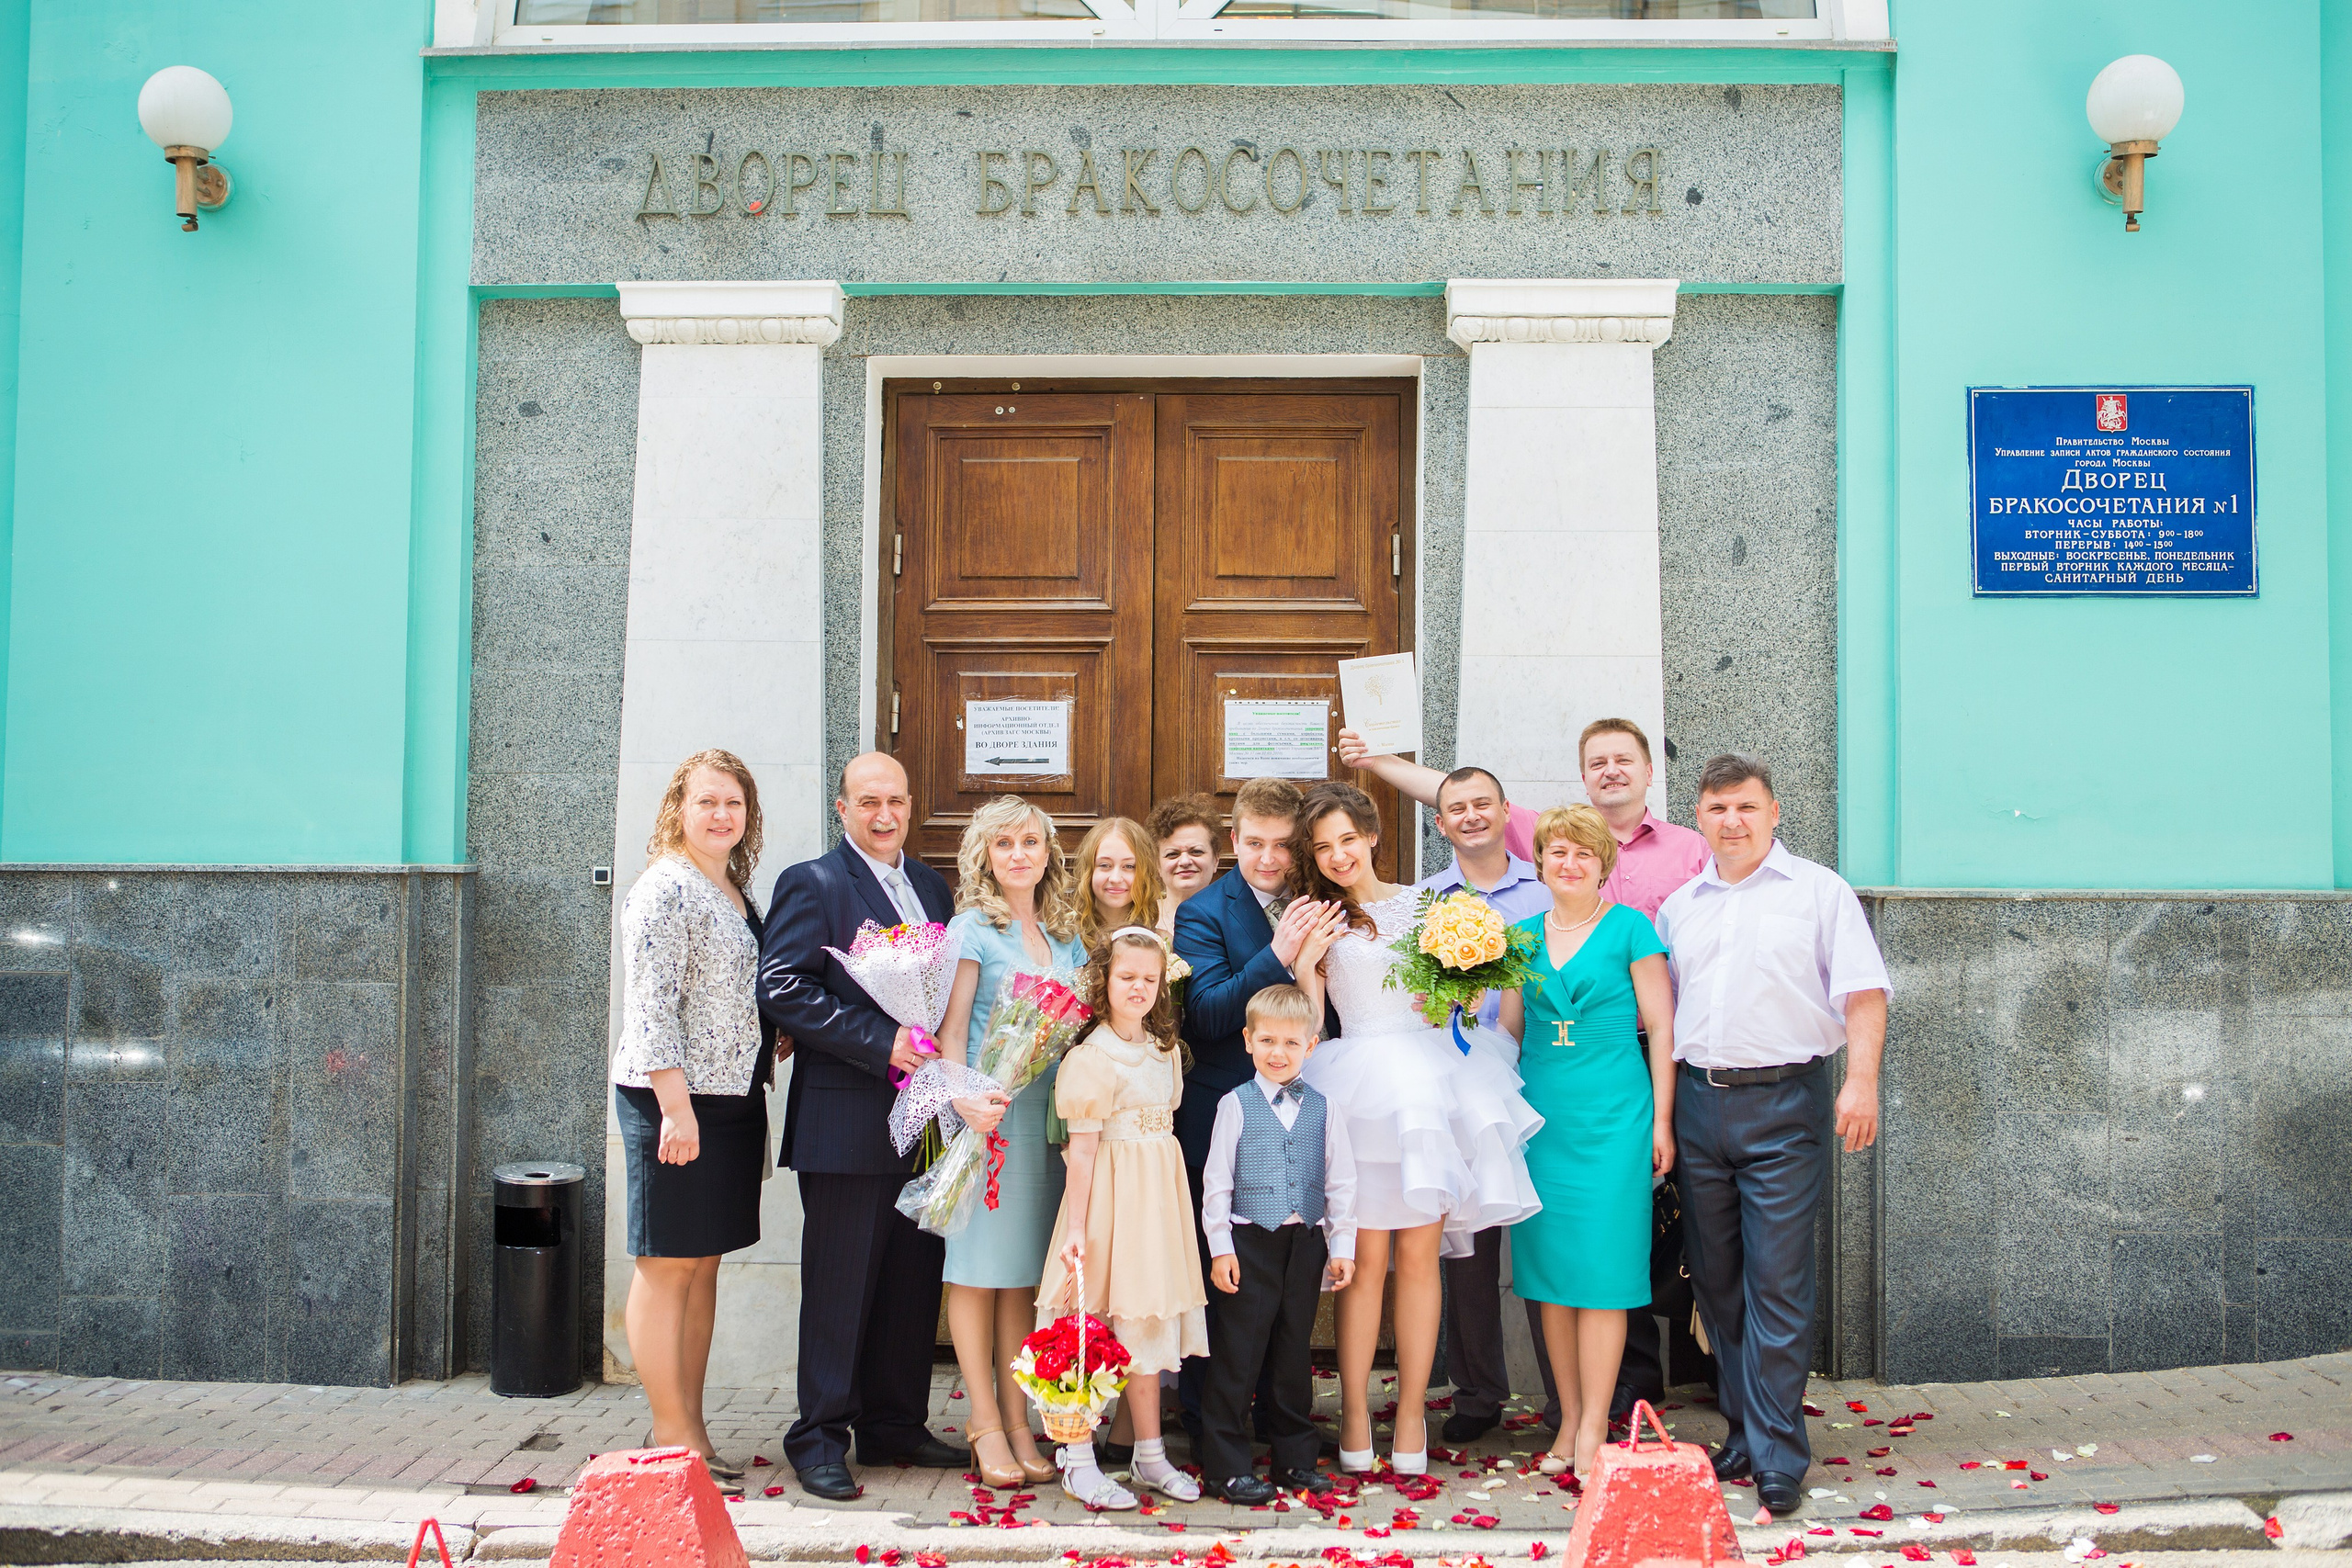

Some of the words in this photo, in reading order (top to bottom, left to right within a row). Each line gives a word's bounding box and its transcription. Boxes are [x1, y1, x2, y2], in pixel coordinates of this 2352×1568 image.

[634, 150, 912, 220] ДВОРЕЦ
[975, 146, 1664, 213] БРАКОСОЧЕТАНИЯ
[1989, 497, 2206, 514] БРАКОСОЧЕТАНИЯ
[2067, 519, 2102, 528] ЧАСЫ
[2111, 519, 2164, 528] РАБОТЫ:
[1994, 551, 2060, 561] ВЫХОДНЫЕ:
[2154, 551, 2235, 561] ПОНЕДЕЛЬНИК
[2001, 559, 2049, 571] ПЕРВЫЙ
[2056, 562, 2109, 571] ВТОРНИК
[2117, 562, 2174, 572] КАЖДОГО
[2044, 570, 2137, 583] САНИТАРНЫЙ
[2145, 573, 2184, 584] ДЕНЬ
